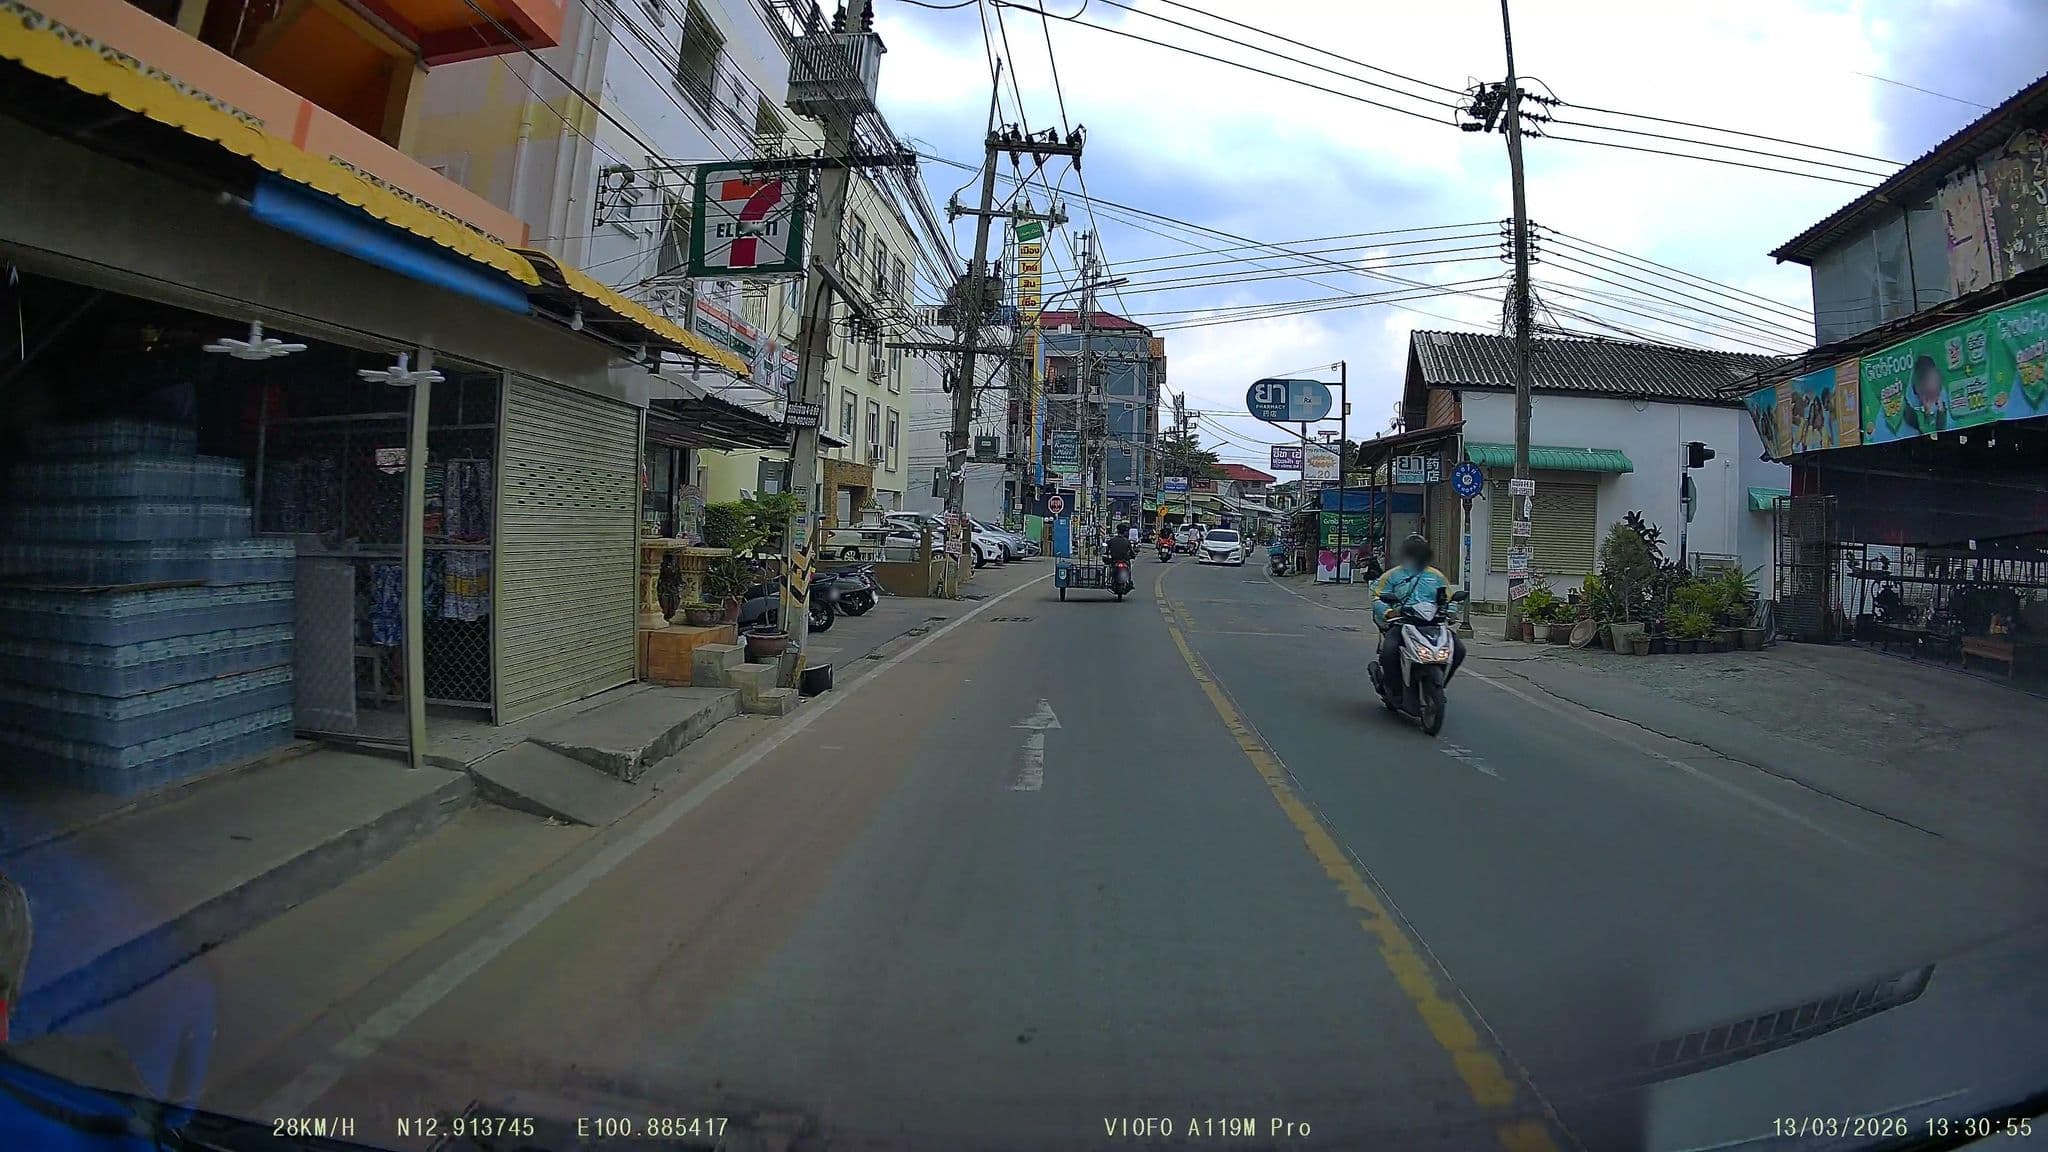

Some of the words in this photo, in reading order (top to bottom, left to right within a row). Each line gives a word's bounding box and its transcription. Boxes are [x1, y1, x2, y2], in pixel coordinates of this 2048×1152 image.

[720, 178, 782, 268] 7
[1255, 384, 1286, 404] ยา
[1399, 457, 1422, 470] ยา
[1426, 457, 1440, 482] 药店
[1317, 470, 1331, 479] 20
